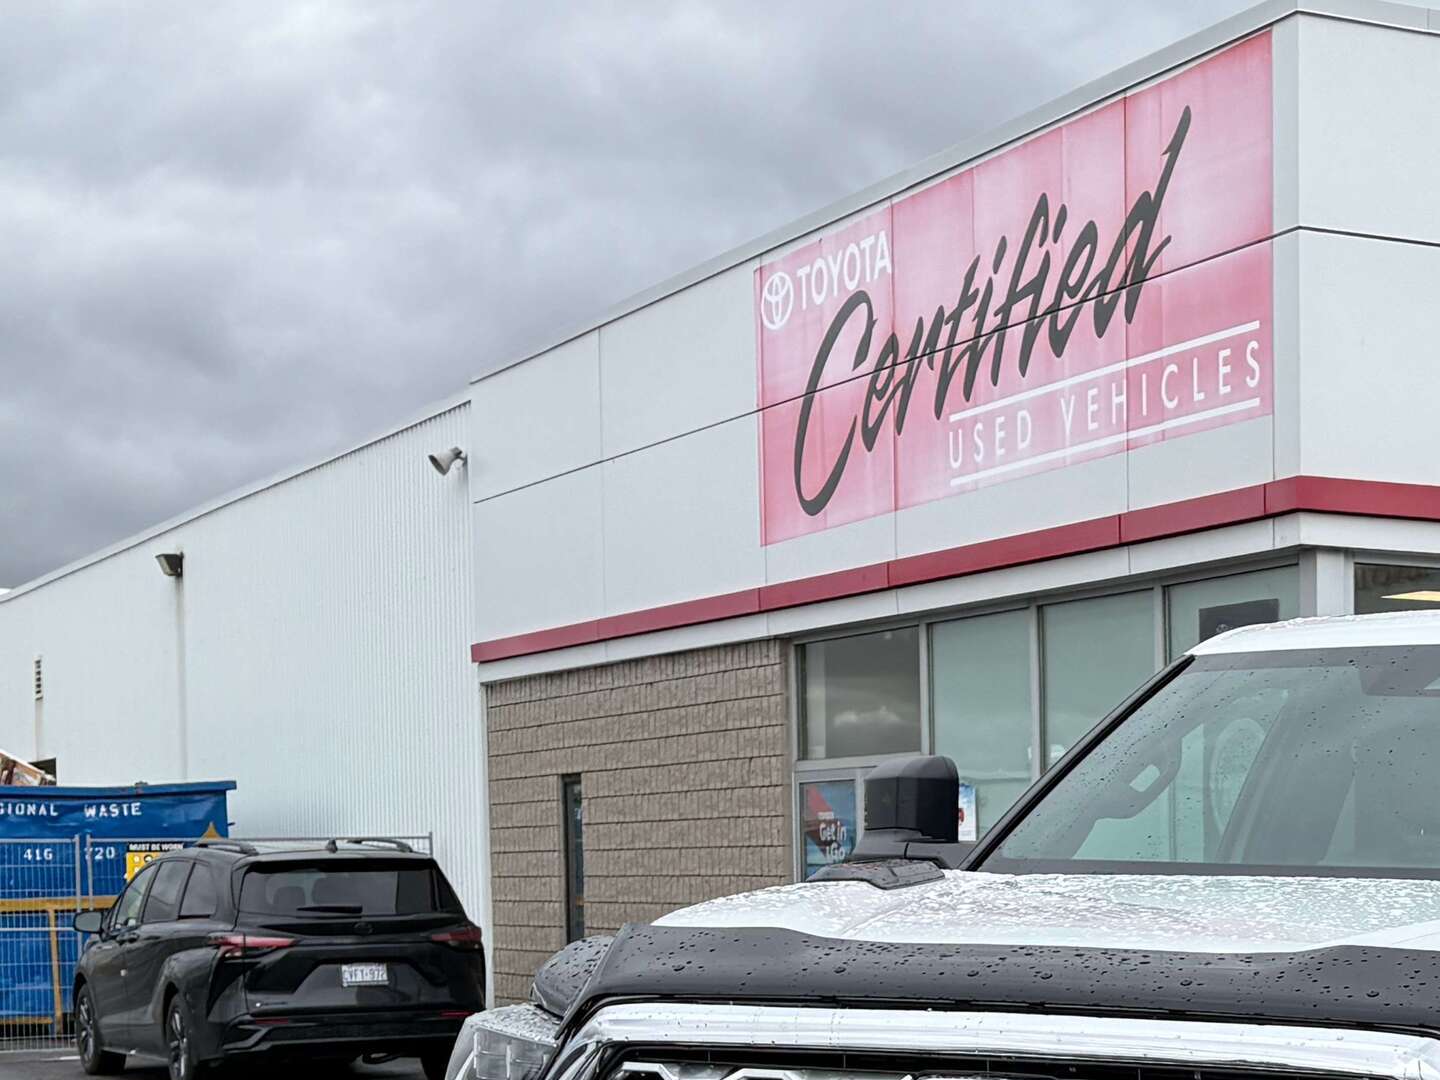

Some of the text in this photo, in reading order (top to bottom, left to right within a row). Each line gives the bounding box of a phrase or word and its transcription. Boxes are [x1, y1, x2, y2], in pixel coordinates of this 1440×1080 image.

[794, 105, 1191, 517] Certified
[796, 230, 892, 310] TOYOTA
[948, 339, 1261, 469] USED VEHICLES
[84, 802, 142, 818] WASTE
